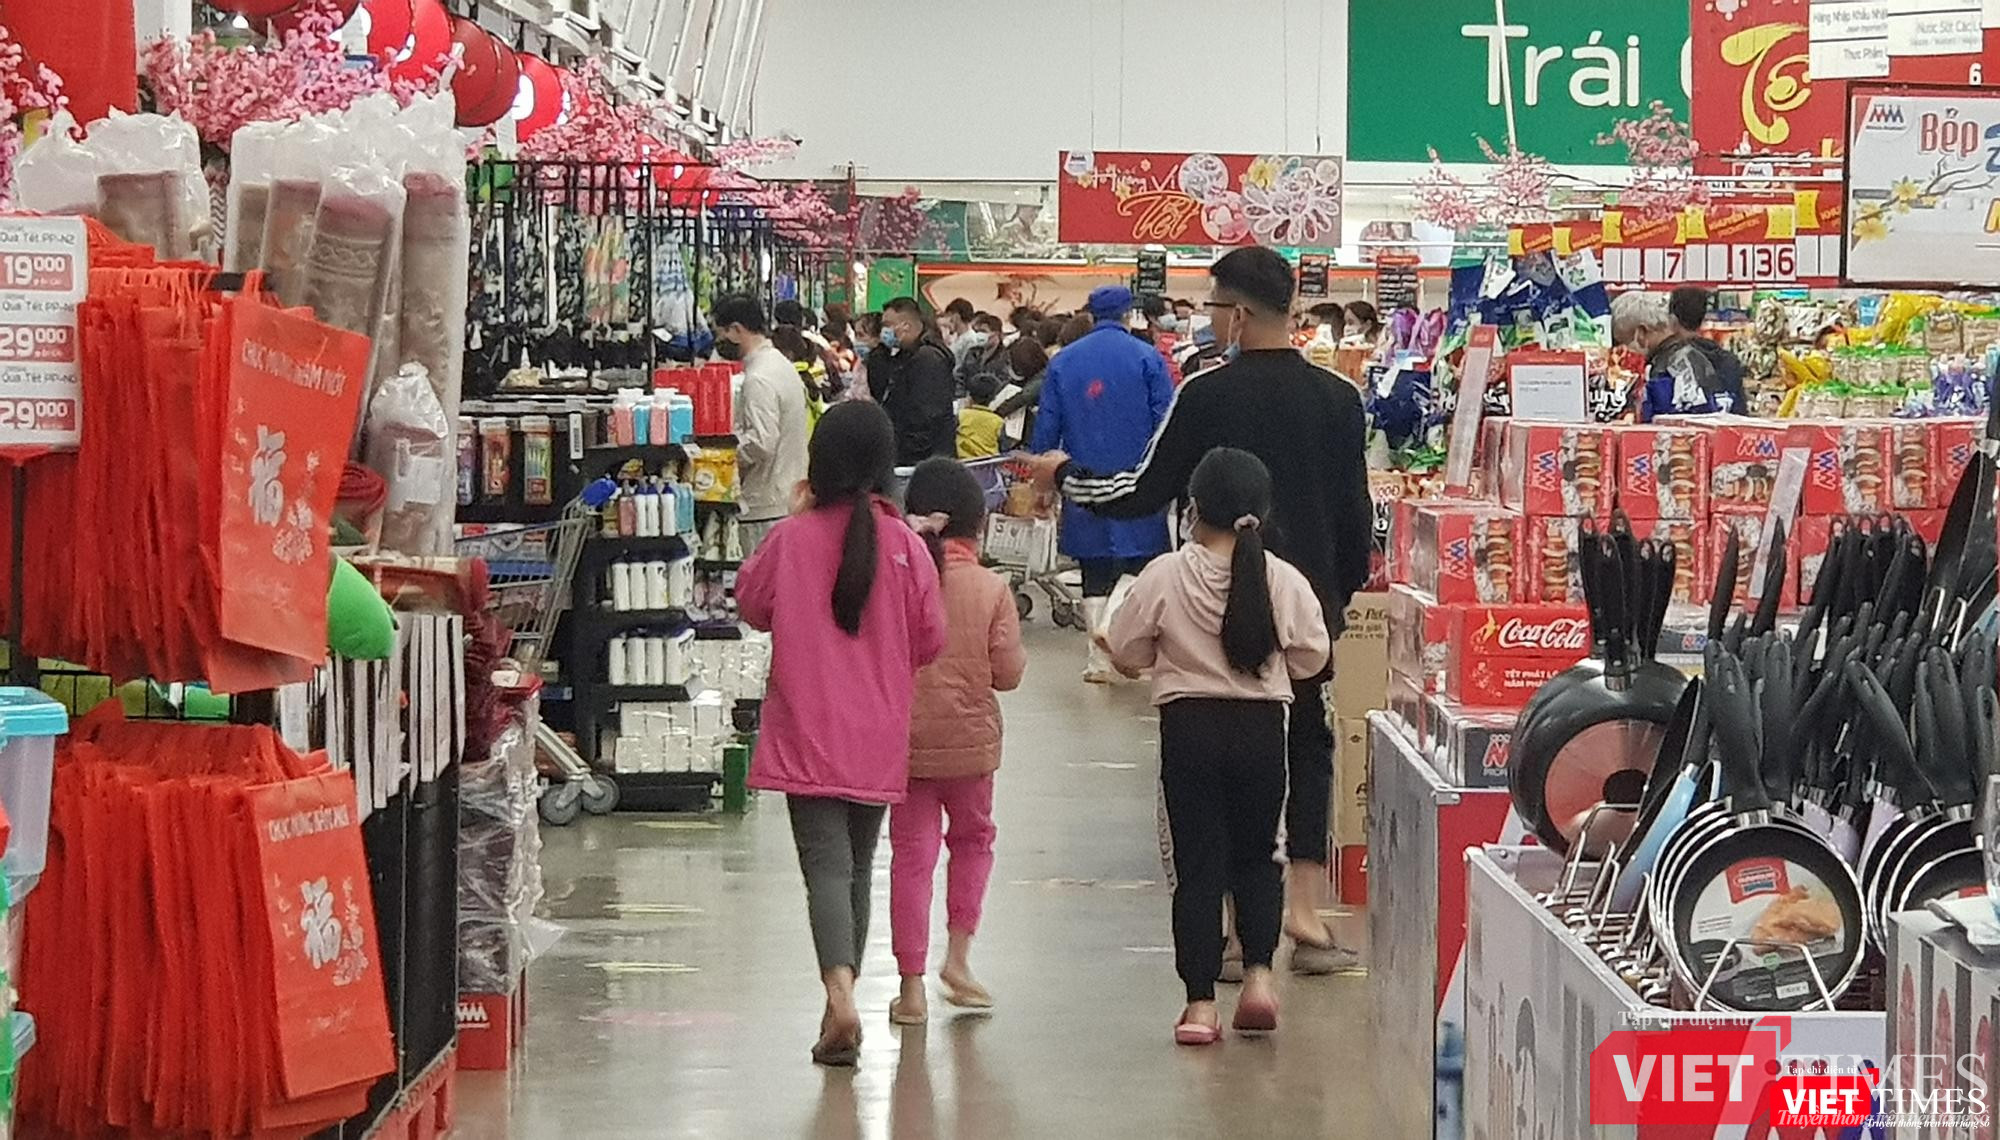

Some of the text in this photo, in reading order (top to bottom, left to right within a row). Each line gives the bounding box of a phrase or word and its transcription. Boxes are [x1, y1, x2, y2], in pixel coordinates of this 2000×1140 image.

[1461, 24, 1640, 107] Trái
[1968, 62, 1982, 86] 6
[1667, 252, 1681, 279] 7
[1738, 248, 1794, 277] 136
